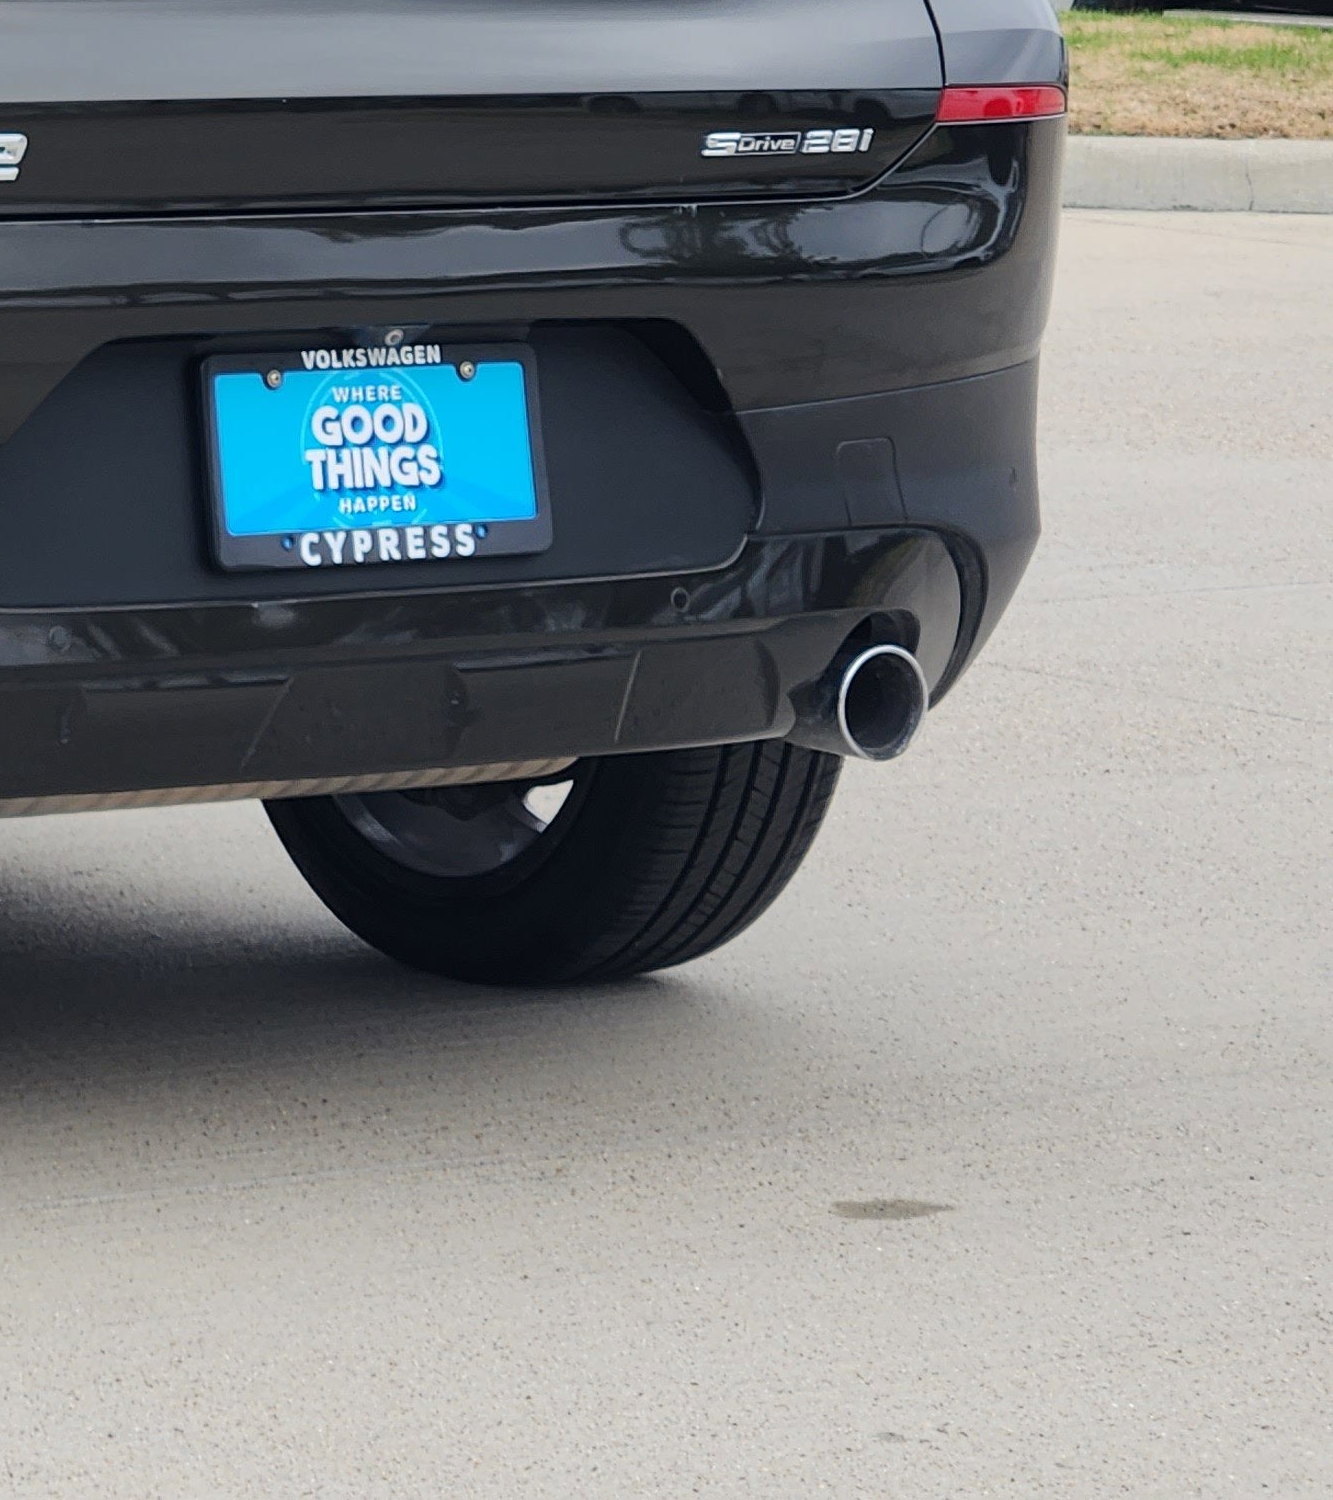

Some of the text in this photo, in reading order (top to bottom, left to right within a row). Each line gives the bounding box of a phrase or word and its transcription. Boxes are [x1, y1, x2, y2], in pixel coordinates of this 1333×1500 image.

[301, 344, 442, 370] VOLKSWAGEN
[331, 384, 403, 403] WHERE
[311, 403, 429, 447] GOOD
[305, 445, 442, 491] THINGS
[338, 493, 417, 514] HAPPEN
[299, 523, 476, 567] CYPRESS
